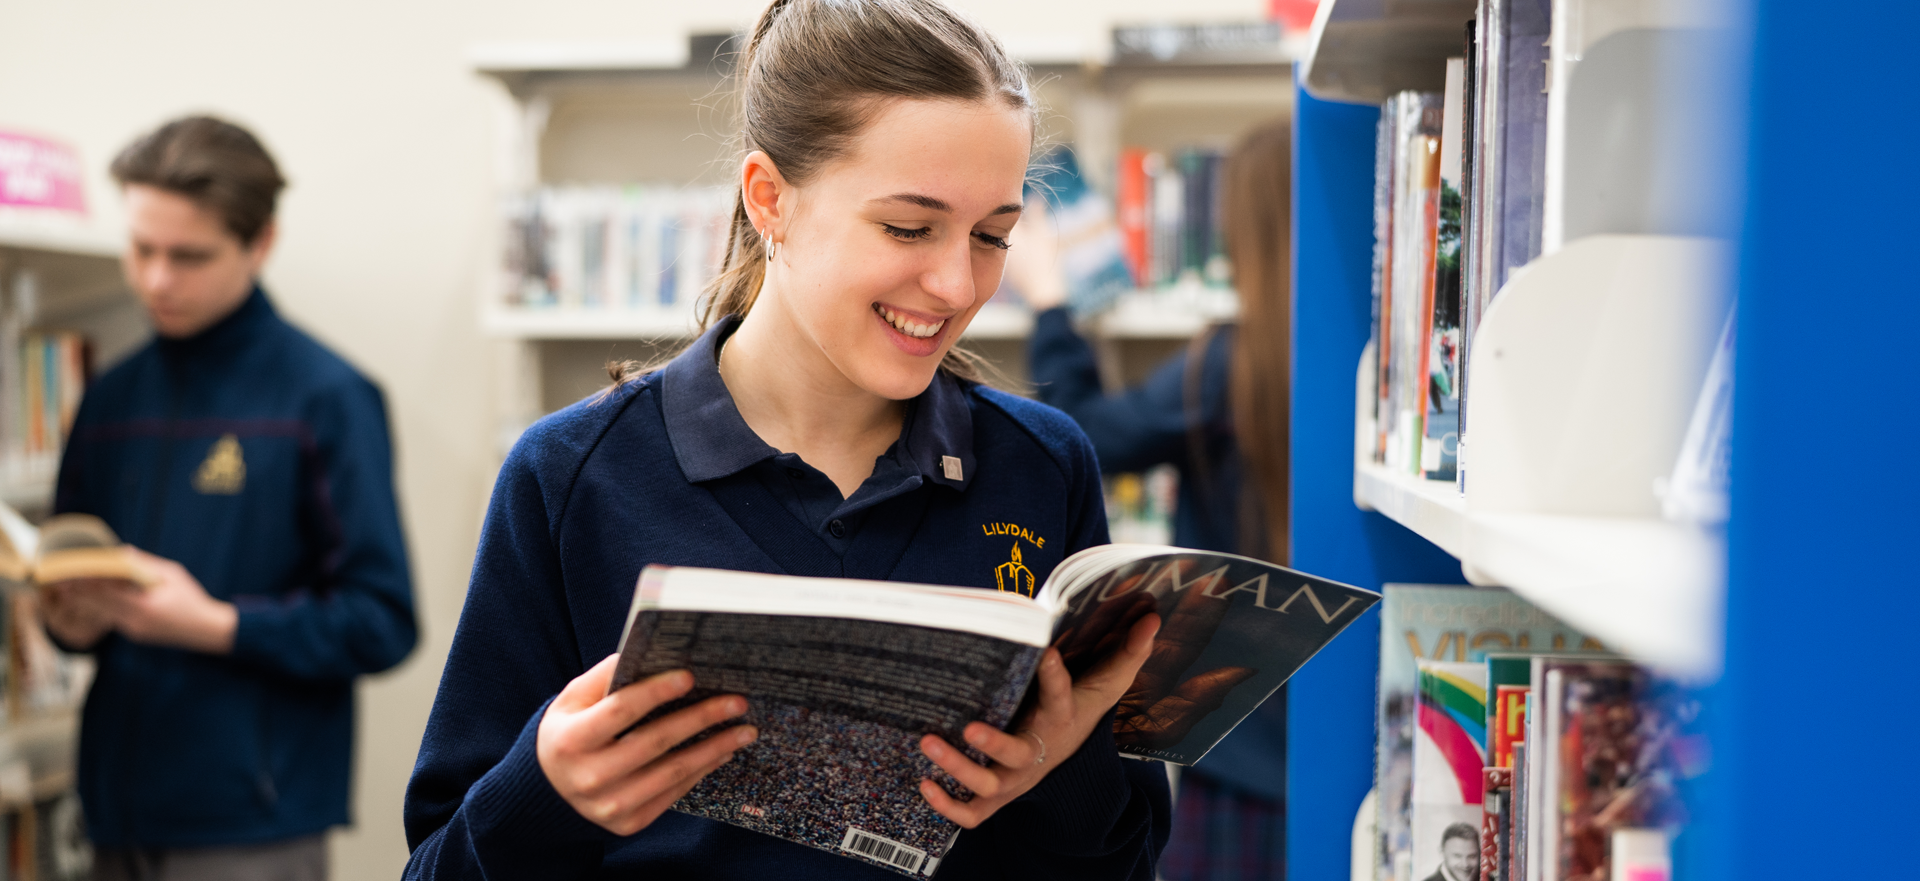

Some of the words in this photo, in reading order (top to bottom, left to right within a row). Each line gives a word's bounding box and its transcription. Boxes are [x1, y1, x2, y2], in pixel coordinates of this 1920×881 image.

[982, 522, 1046, 549] LILYDALE
[1134, 746, 1185, 760] PEOPLES
[740, 804, 764, 818] DK
